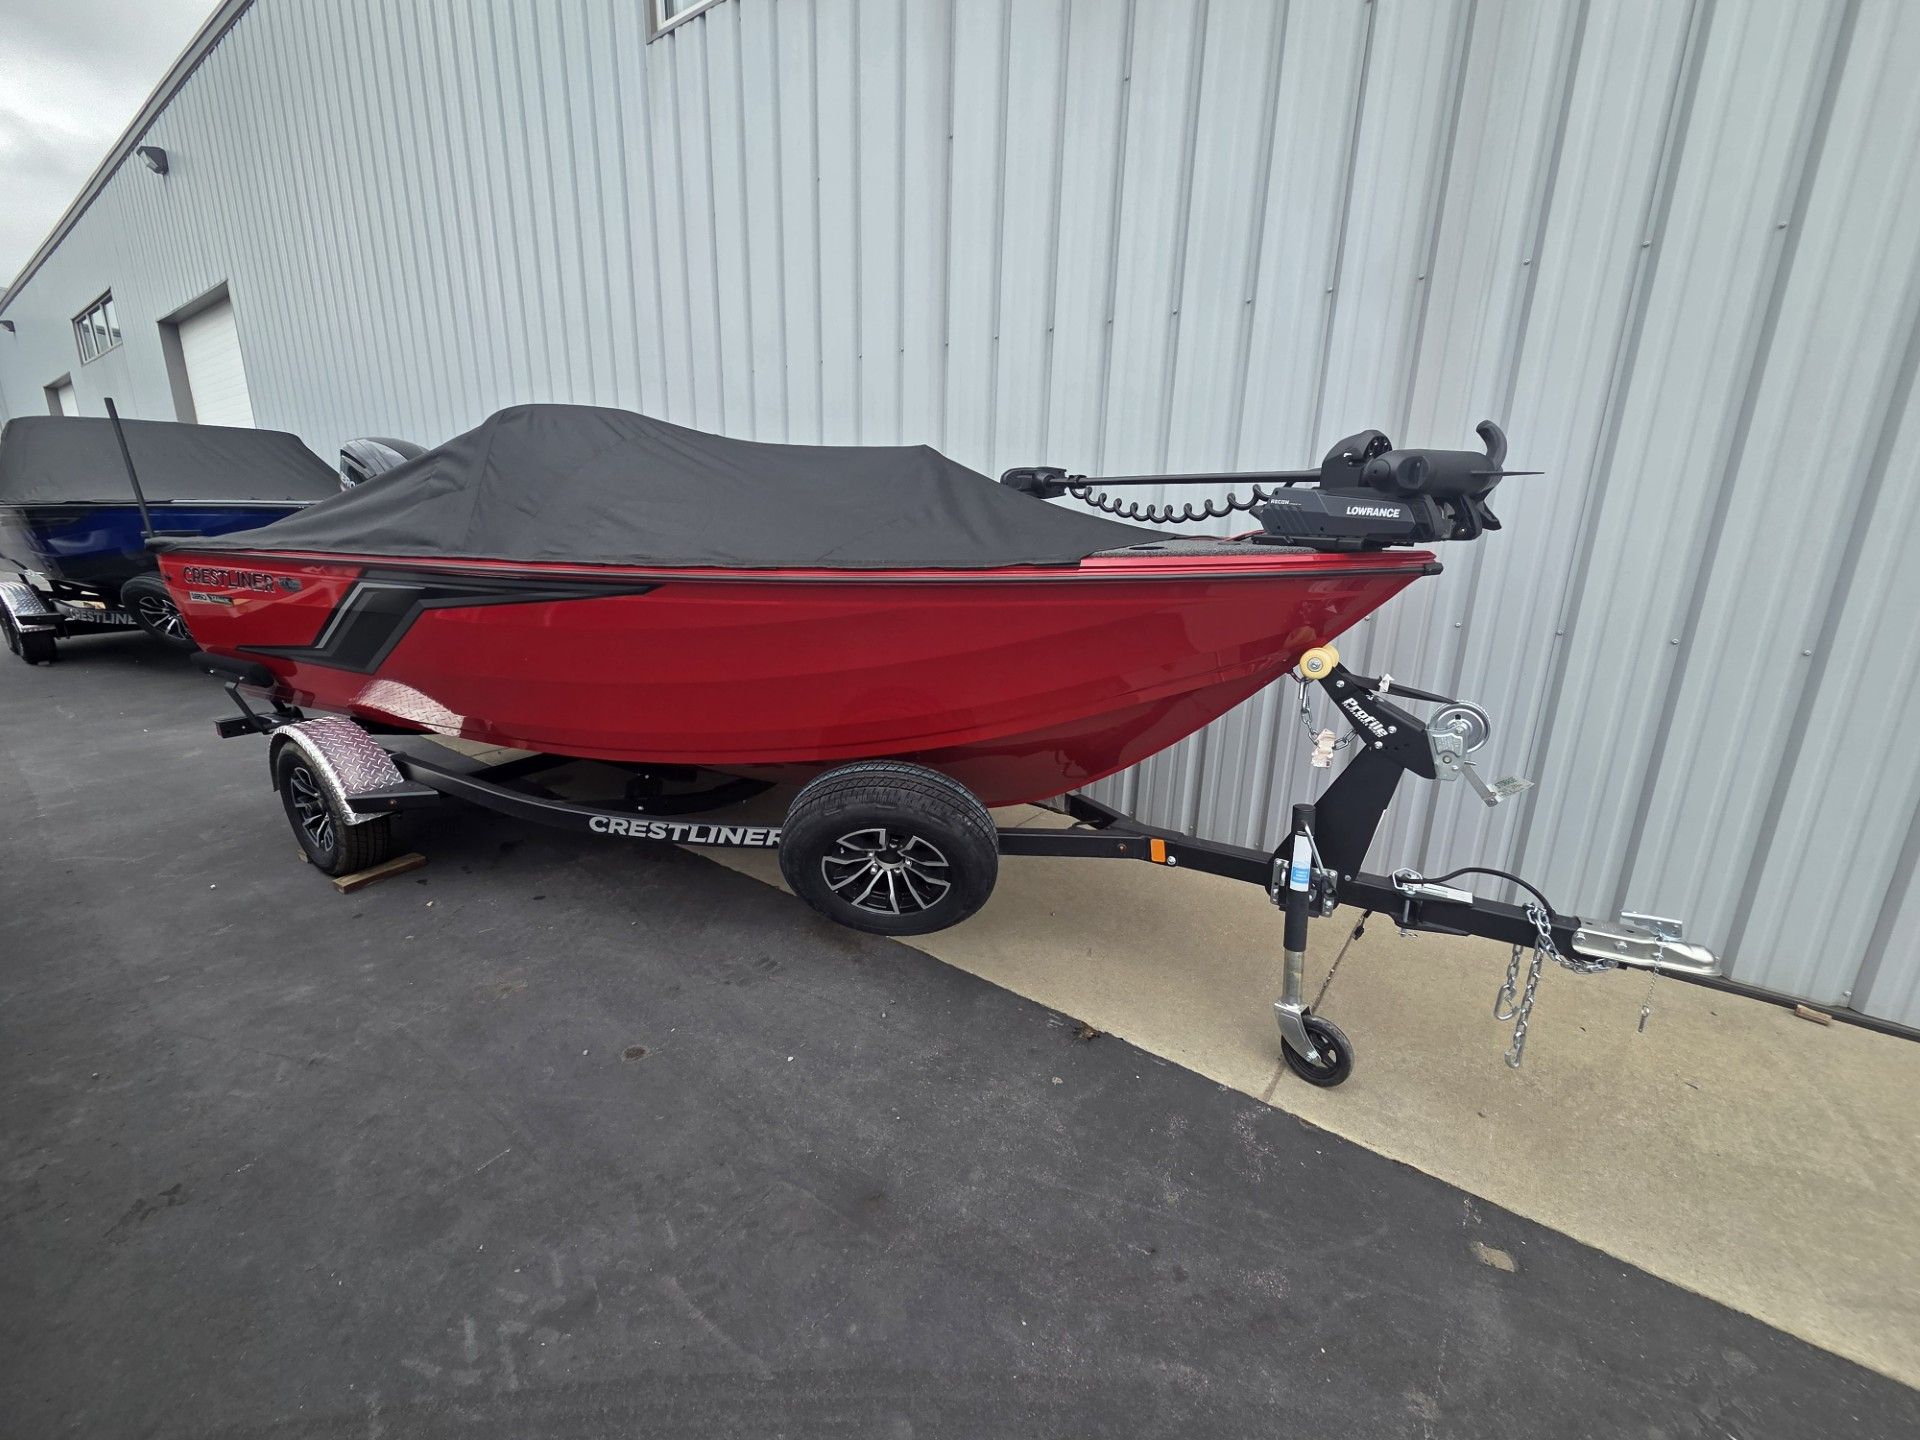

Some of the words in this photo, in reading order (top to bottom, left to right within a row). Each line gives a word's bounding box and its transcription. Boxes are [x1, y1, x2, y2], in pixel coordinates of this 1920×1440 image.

[1346, 506, 1401, 518] LOWRANCE
[183, 566, 275, 593] CRESTLINER
[69, 608, 138, 625] CRESTLINE
[1342, 697, 1388, 736] Profile
[588, 816, 782, 847] CRESTLINER
